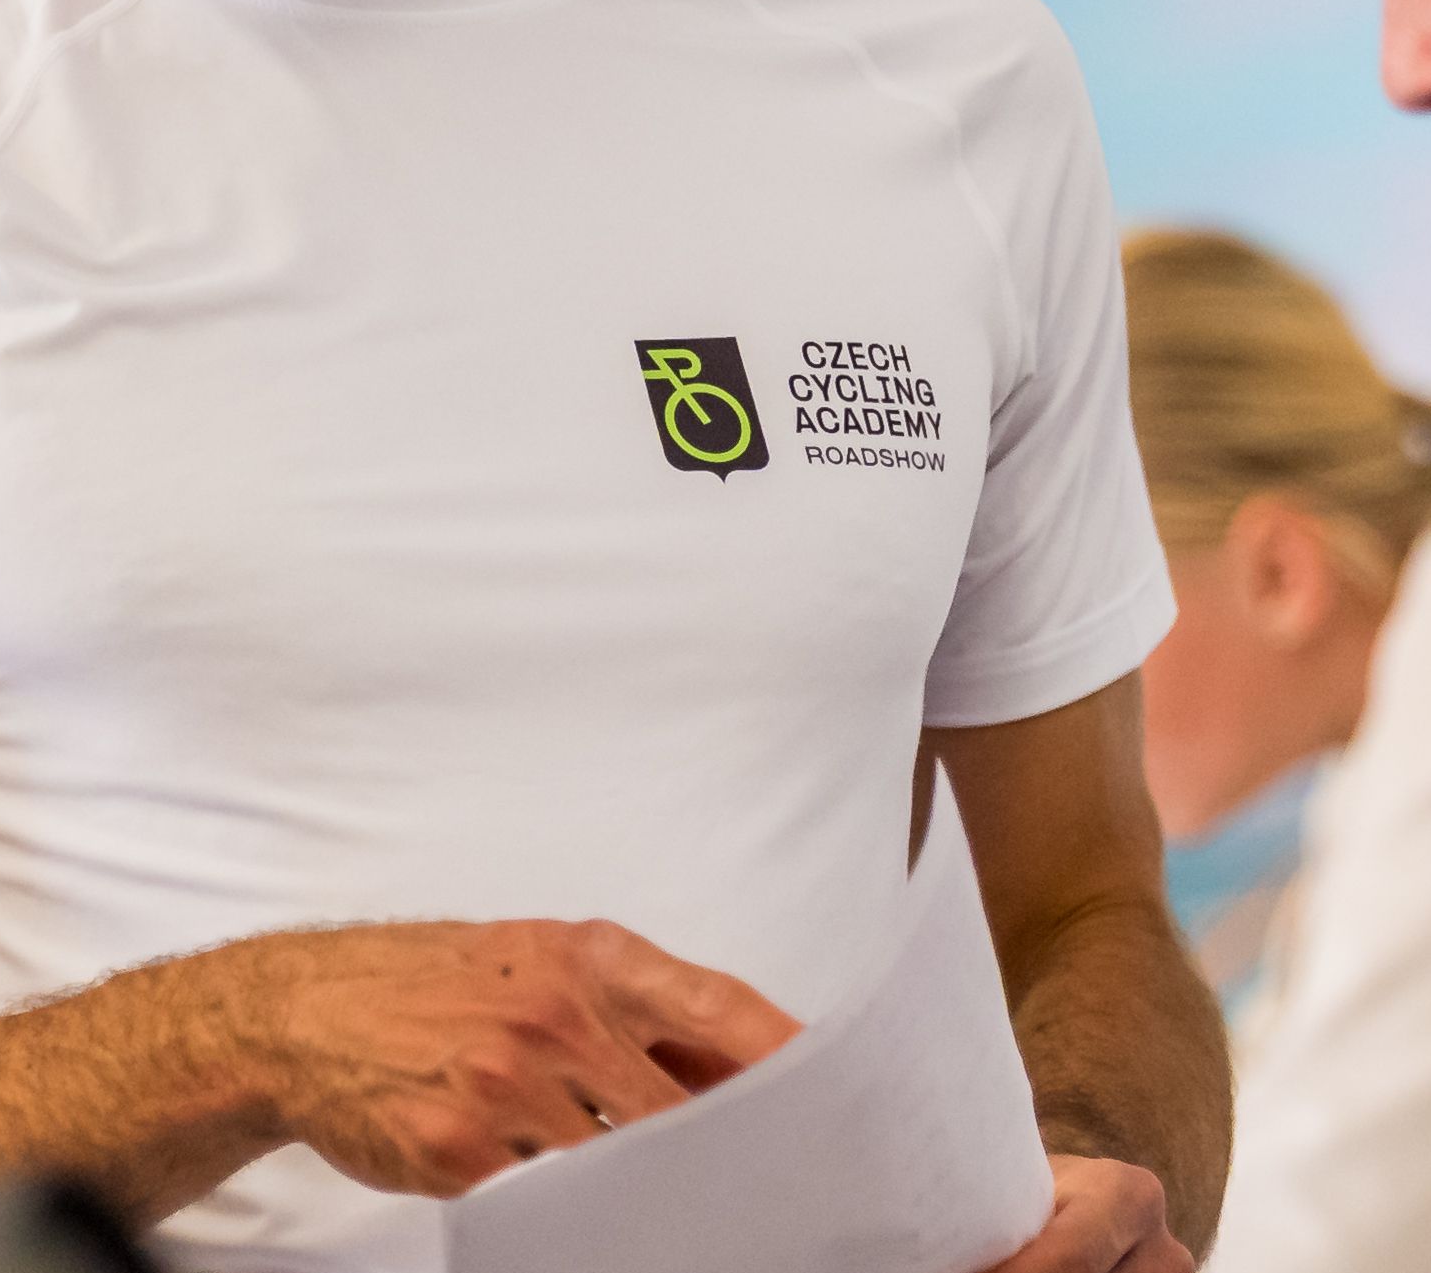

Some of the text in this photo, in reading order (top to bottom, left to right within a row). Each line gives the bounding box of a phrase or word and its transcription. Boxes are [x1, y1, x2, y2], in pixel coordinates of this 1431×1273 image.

[801, 341, 912, 373] CZECH
[788, 374, 937, 407] CYCLING
[795, 407, 942, 440] ACADEMY
[805, 445, 946, 472] ROADSHOW
